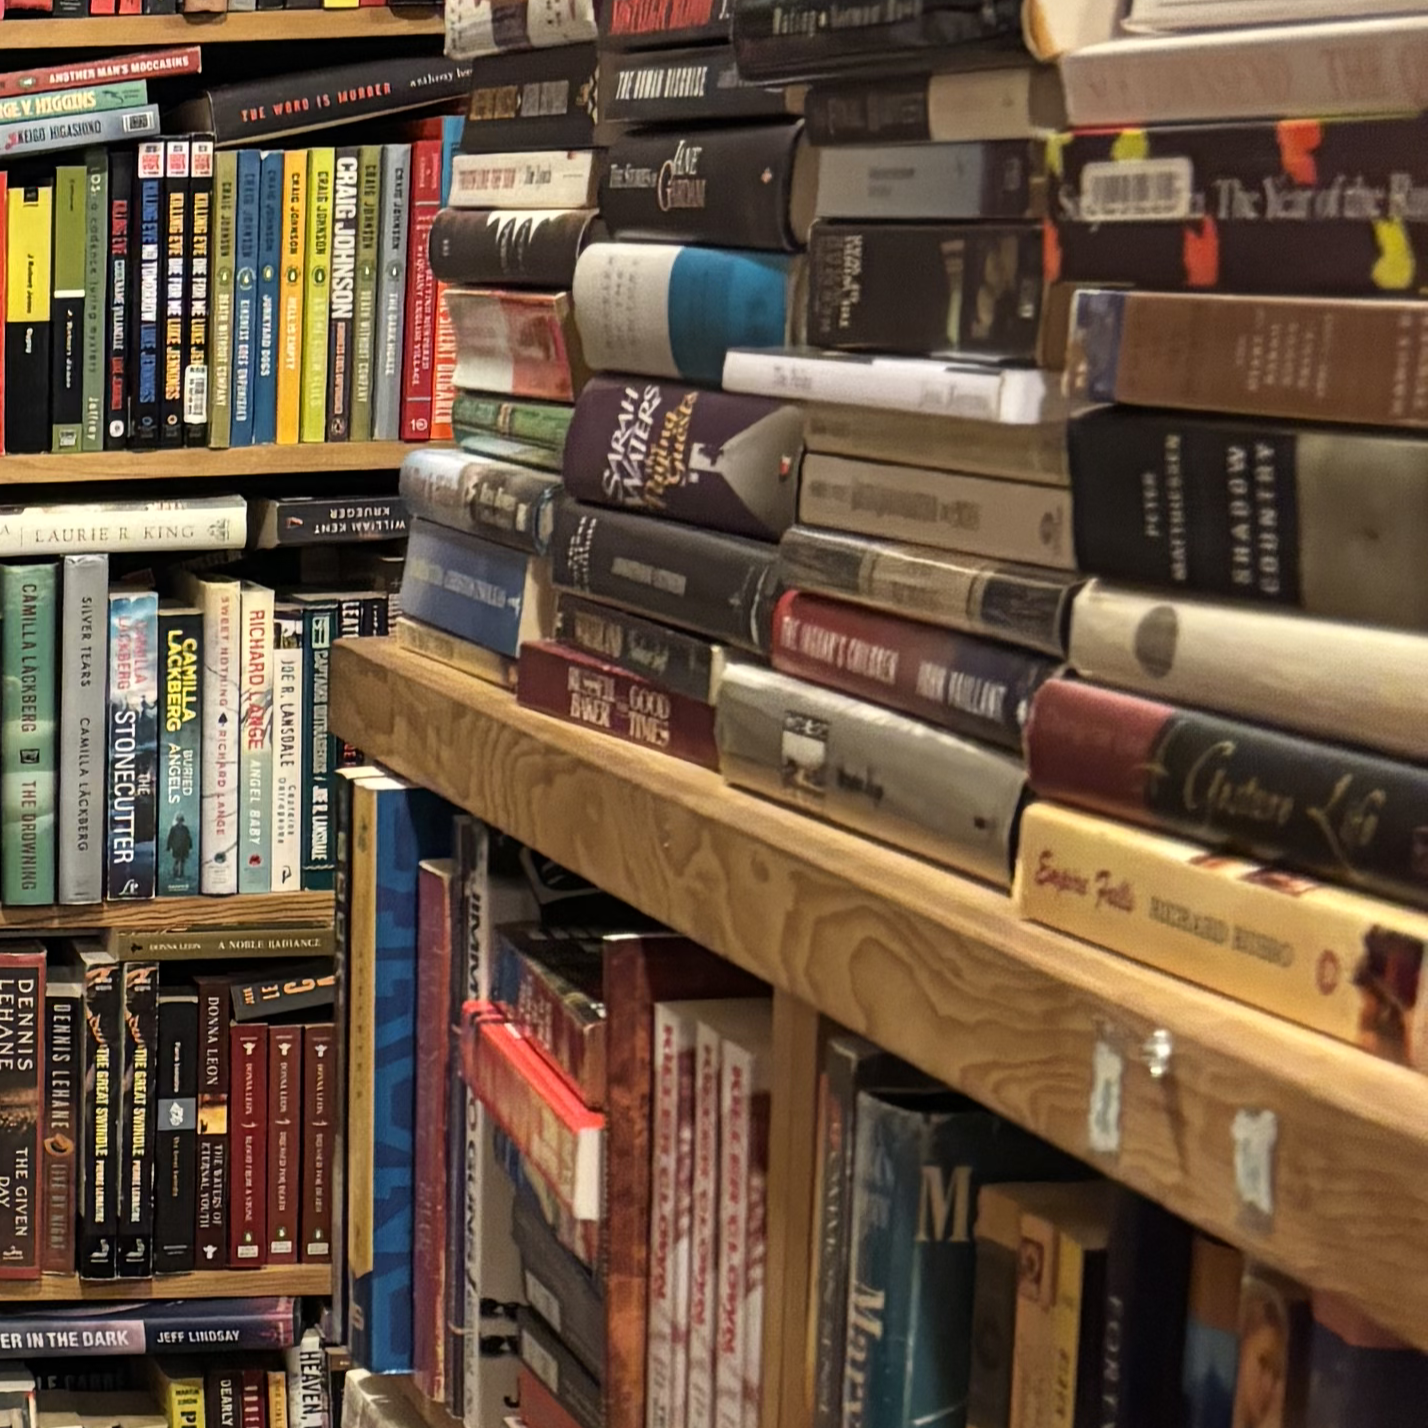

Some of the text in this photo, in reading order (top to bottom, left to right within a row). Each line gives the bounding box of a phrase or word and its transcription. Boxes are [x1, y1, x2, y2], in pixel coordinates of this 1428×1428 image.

[273, 97, 331, 115] WORD IS
[1230, 446, 1251, 586] SHADOW
[1260, 443, 1280, 595] COUNTRY
[629, 685, 671, 720] GOOD
[114, 711, 135, 865] STONECUTTER
[28, 1333, 44, 1347] IN
[49, 1332, 78, 1347] THE
[83, 1329, 129, 1346] DARK
[156, 1329, 239, 1344] JEFF LINDSAY
